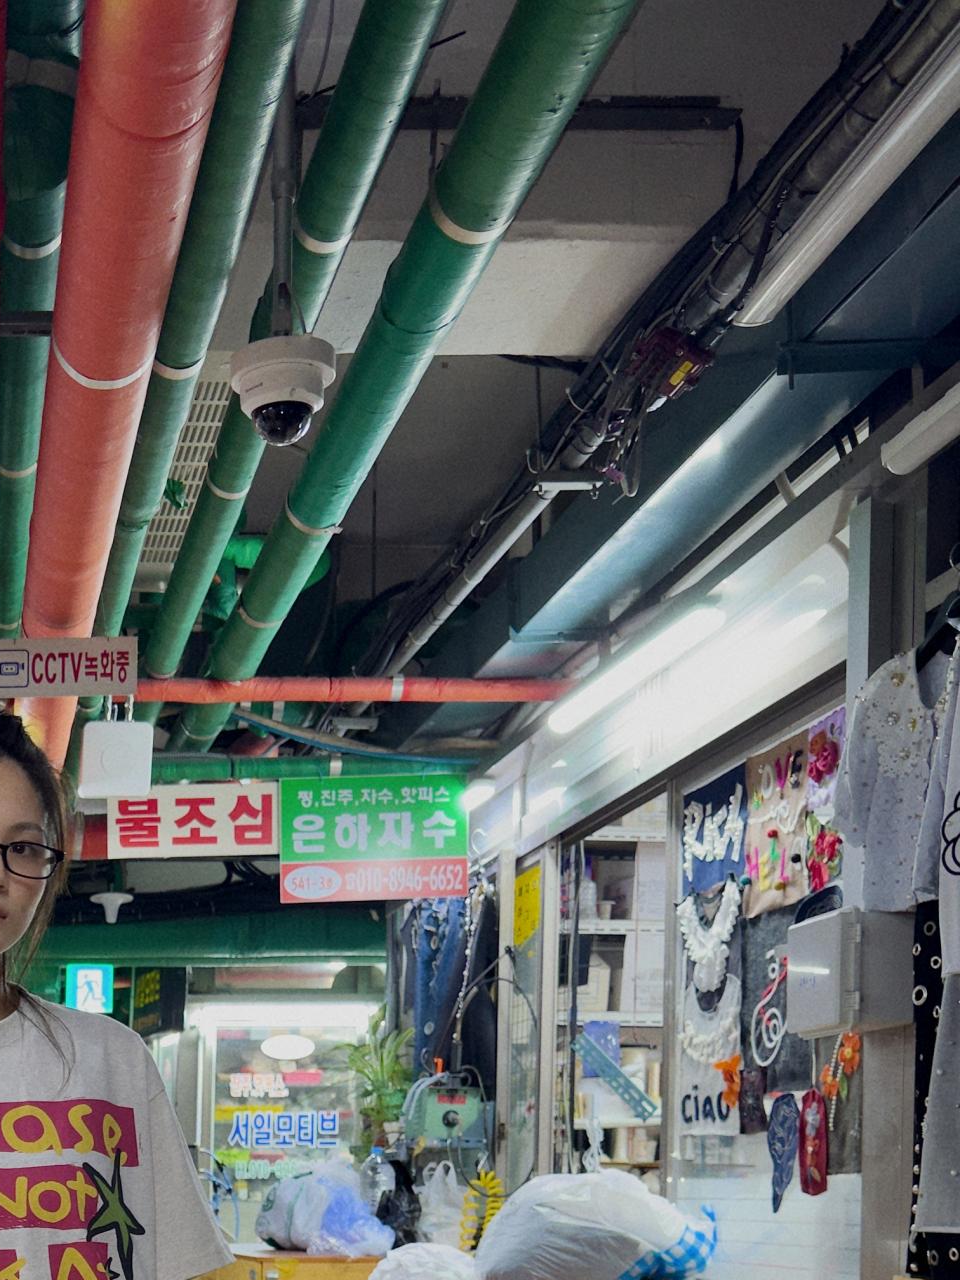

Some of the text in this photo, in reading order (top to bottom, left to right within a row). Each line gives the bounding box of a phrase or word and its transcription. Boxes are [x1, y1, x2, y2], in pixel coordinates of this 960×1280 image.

[31, 650, 130, 684] CCTV녹화중
[115, 794, 273, 848] 불조심
[292, 810, 456, 853] 은하자수
[228, 1111, 339, 1148] 서일모티브
